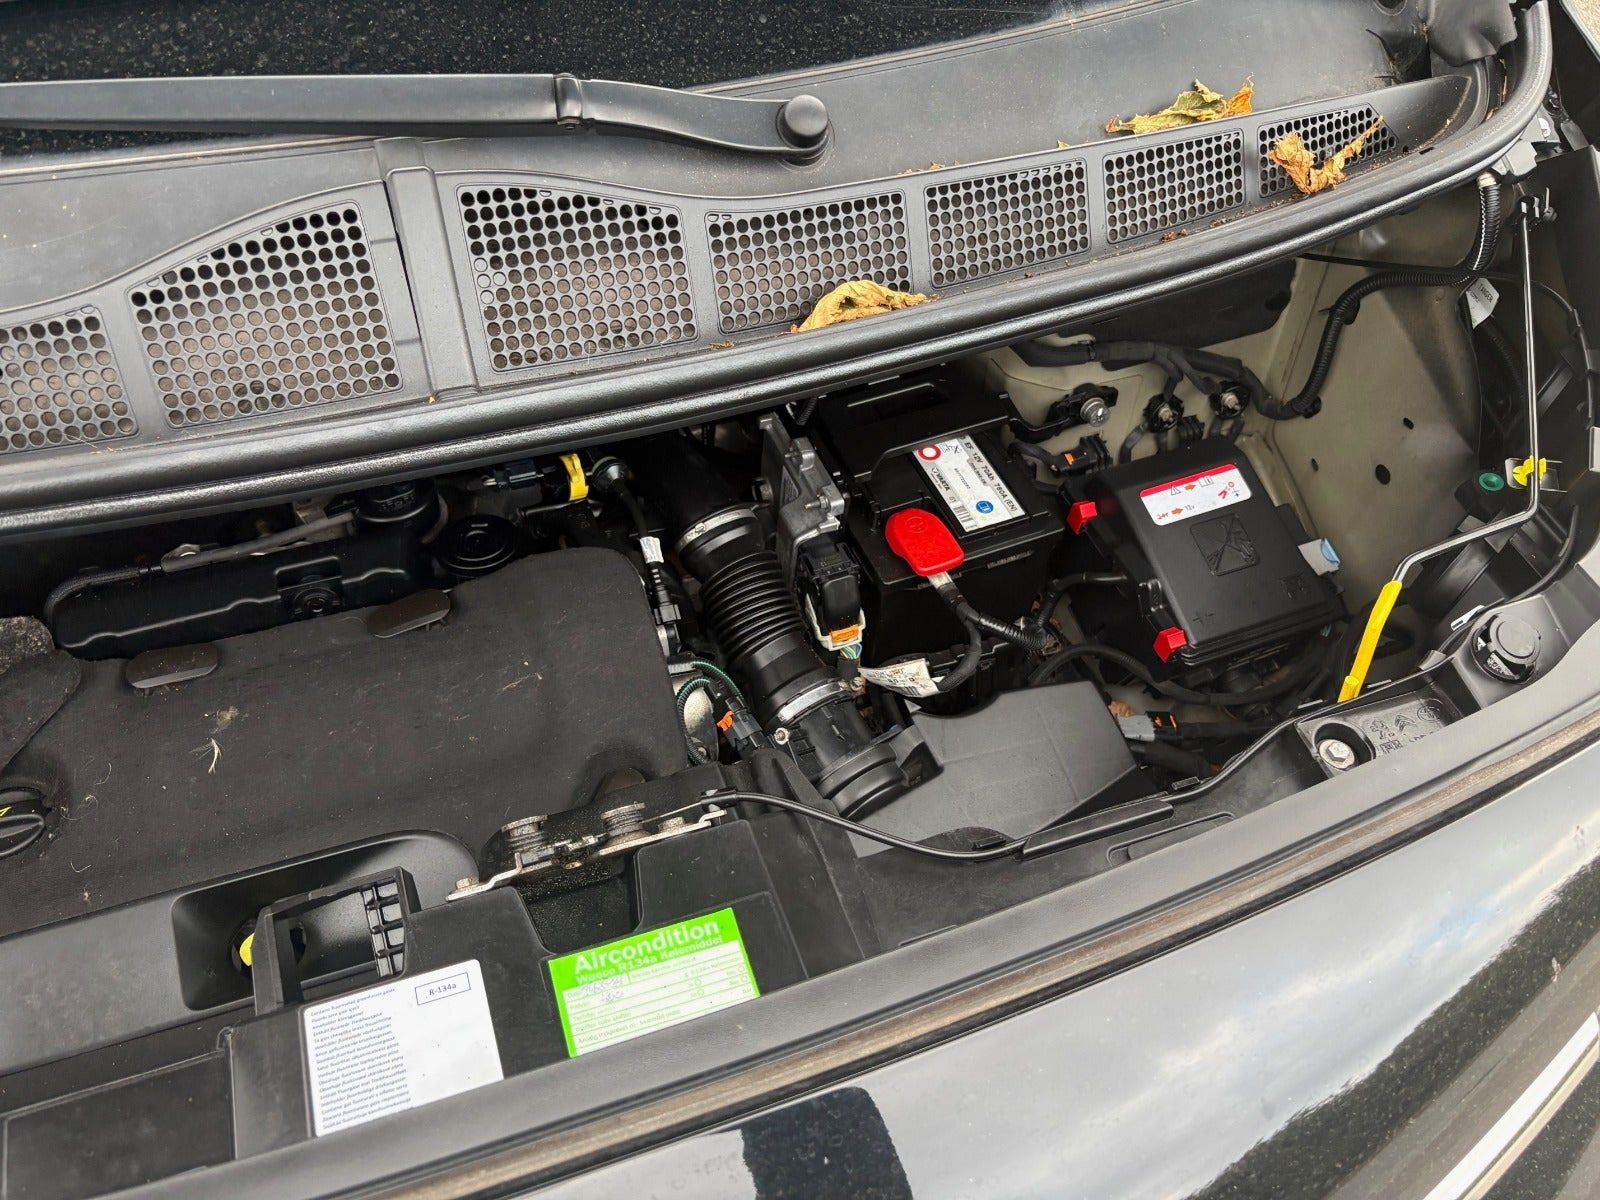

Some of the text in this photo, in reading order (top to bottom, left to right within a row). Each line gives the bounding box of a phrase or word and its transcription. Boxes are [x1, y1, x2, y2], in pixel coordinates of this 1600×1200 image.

[972, 452, 983, 463] 12V
[981, 465, 995, 481] 70Ah
[936, 473, 951, 491] VARTA
[574, 920, 720, 975] Aircondition
[619, 955, 658, 973] R134a
[428, 983, 457, 996] R-134a
